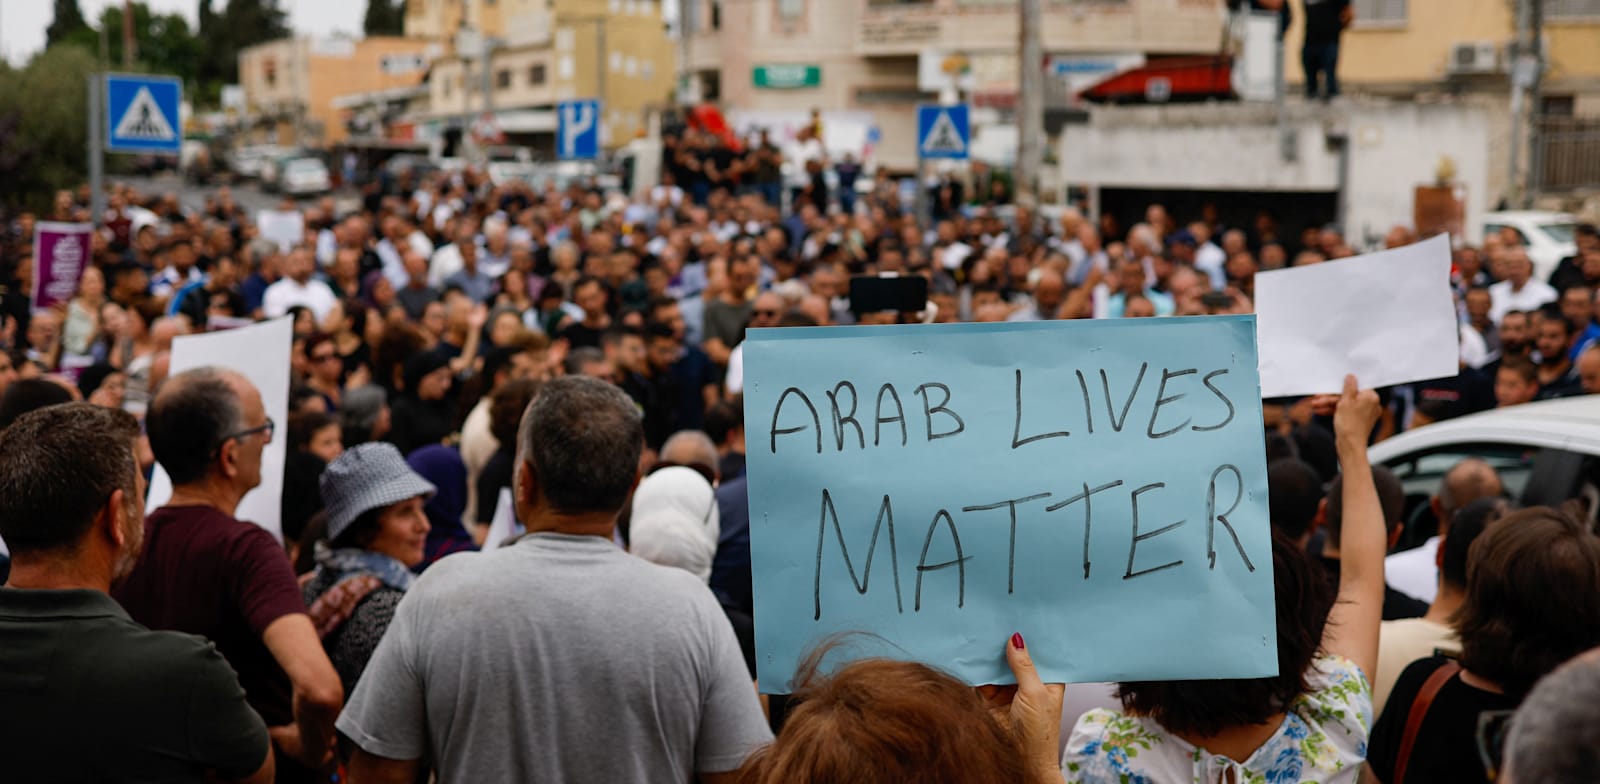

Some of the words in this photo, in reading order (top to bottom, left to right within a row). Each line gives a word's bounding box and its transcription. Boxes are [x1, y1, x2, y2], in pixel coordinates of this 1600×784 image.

[769, 380, 965, 454] ARAB
[1011, 361, 1235, 450] LIVES
[813, 463, 1256, 622] MATTER
